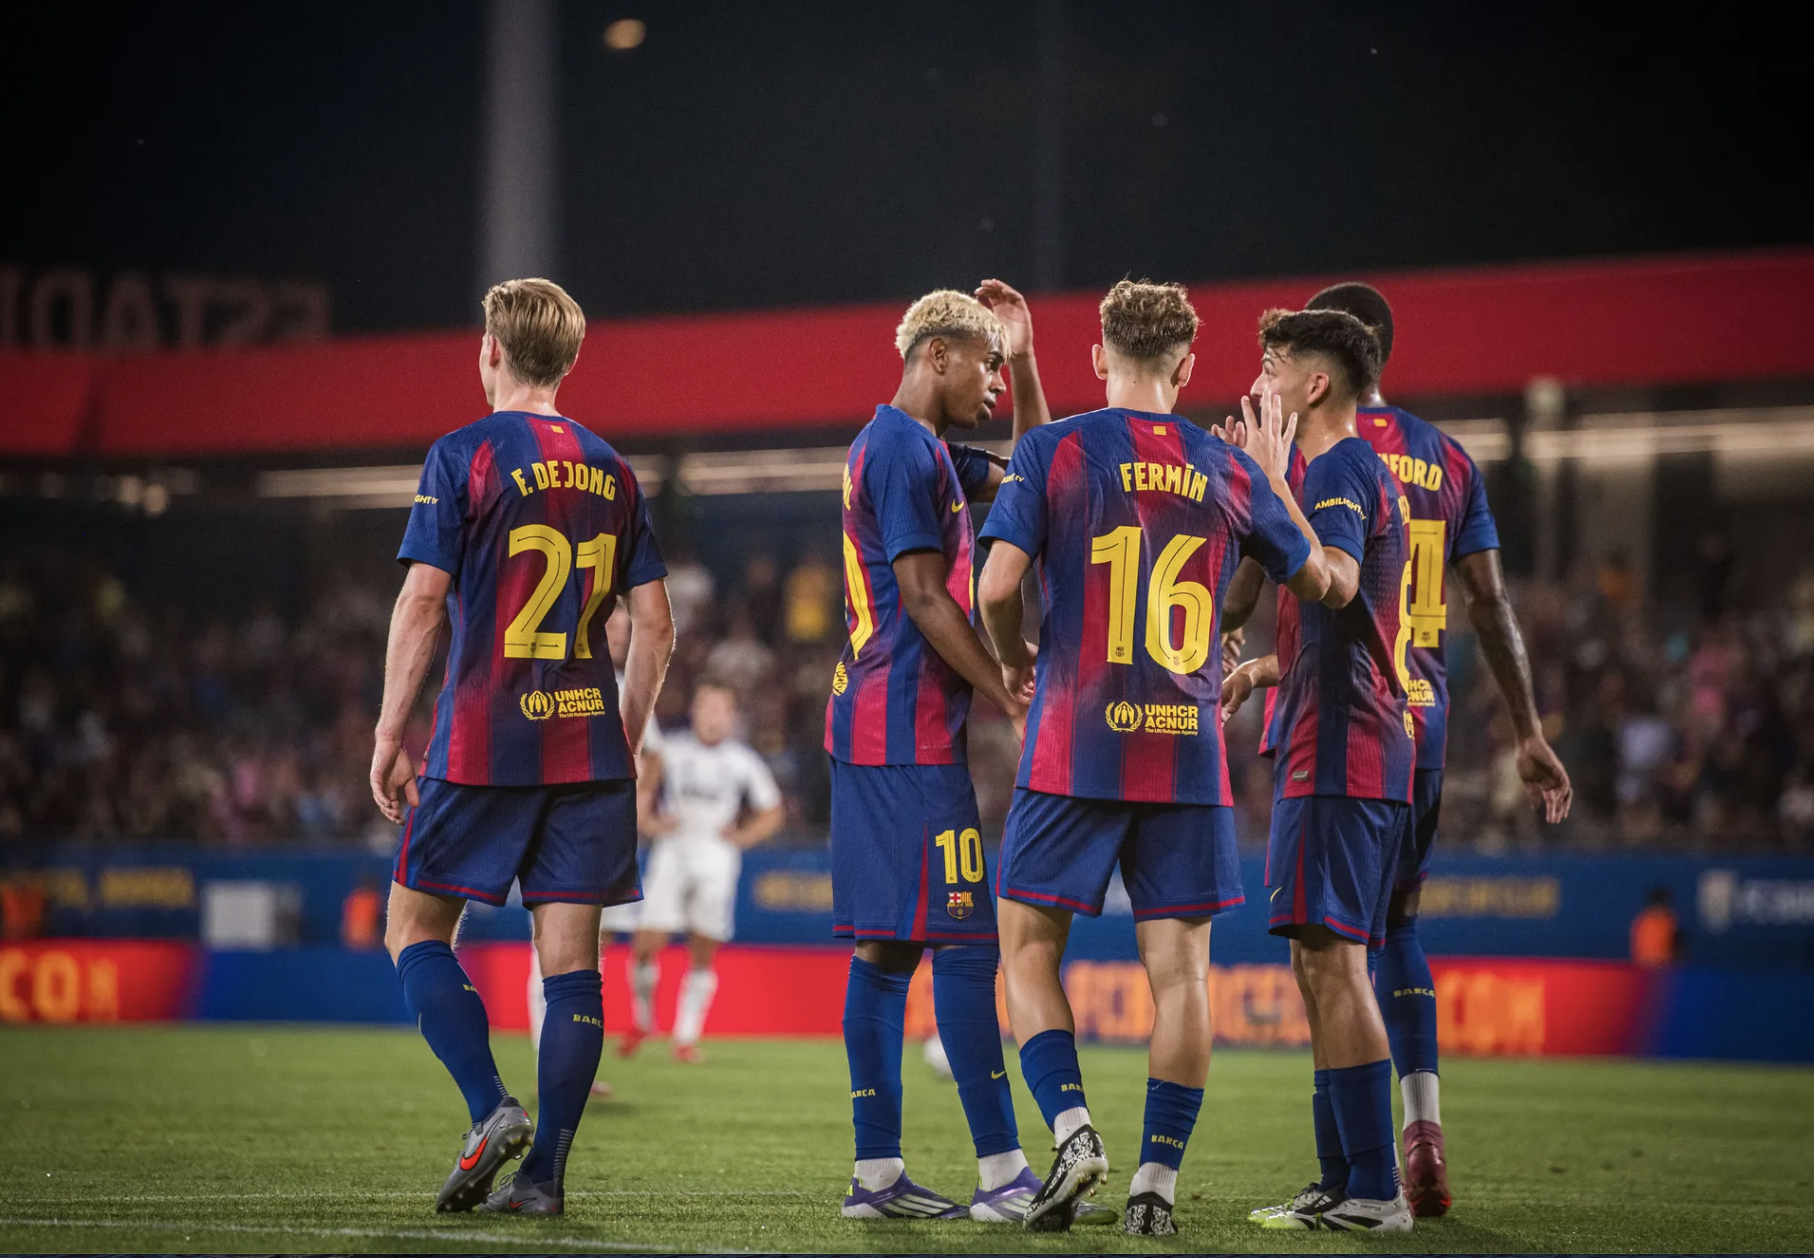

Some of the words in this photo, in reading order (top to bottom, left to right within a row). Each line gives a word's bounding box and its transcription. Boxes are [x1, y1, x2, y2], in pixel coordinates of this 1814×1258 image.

[510, 467, 534, 497] F.
[531, 460, 562, 490] DE
[563, 460, 616, 501] JONG
[1377, 453, 1443, 492] FORD
[504, 523, 617, 659] 21
[1091, 525, 1212, 675] 16
[554, 687, 602, 702] UNHCR
[557, 699, 605, 713] ACNUR
[1144, 704, 1199, 718] UNHCR
[1144, 716, 1198, 730] ACNUR
[935, 827, 984, 884] 10
[1060, 1083, 1084, 1093] BAR
